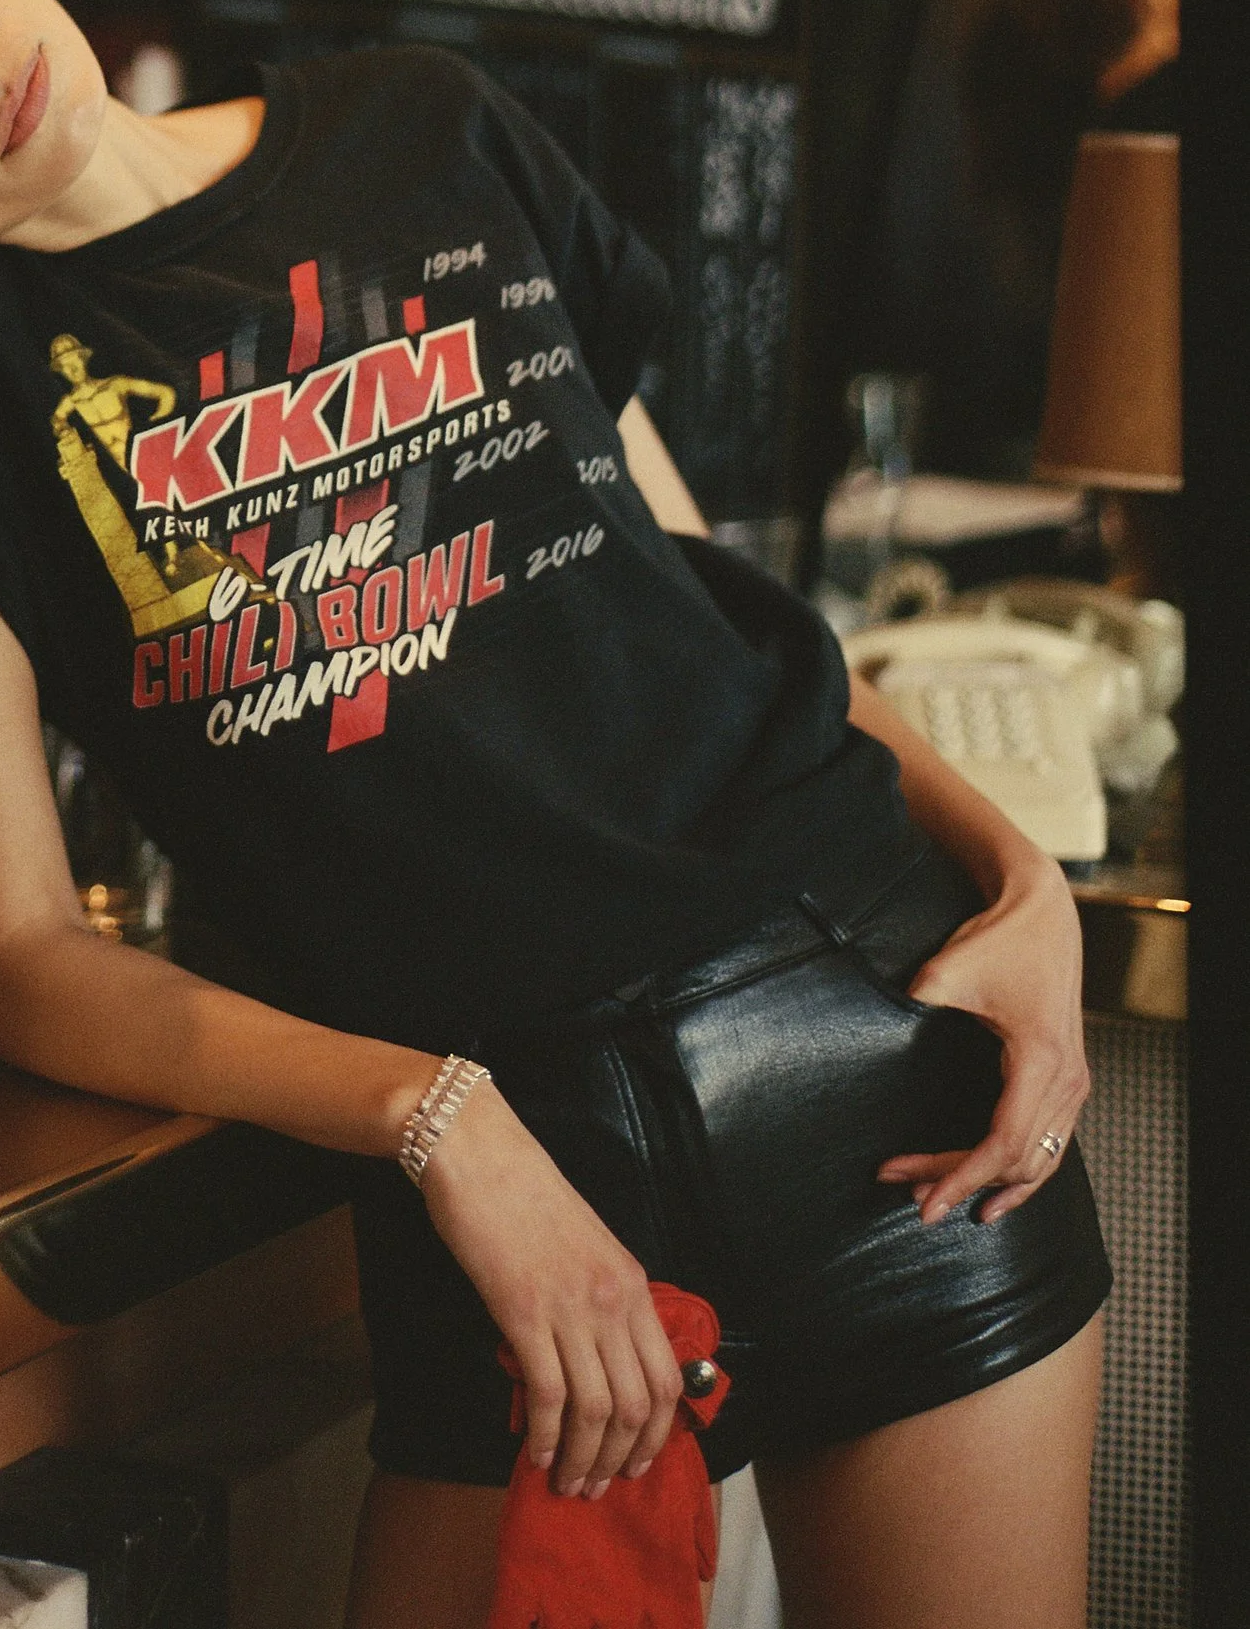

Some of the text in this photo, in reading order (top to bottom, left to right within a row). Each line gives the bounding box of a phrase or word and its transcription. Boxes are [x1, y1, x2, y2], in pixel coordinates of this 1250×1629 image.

[423, 241, 488, 282] 1994
[130, 317, 486, 512] KKM
[143, 398, 512, 544] KEITH KUNZ MOTORSPORTS
[452, 419, 551, 483] 2002
[131, 519, 505, 709] CHILI BOWL
[208, 503, 400, 623] 6-TIME
[525, 522, 605, 581] 2016
[205, 606, 457, 747] CHAMPION
